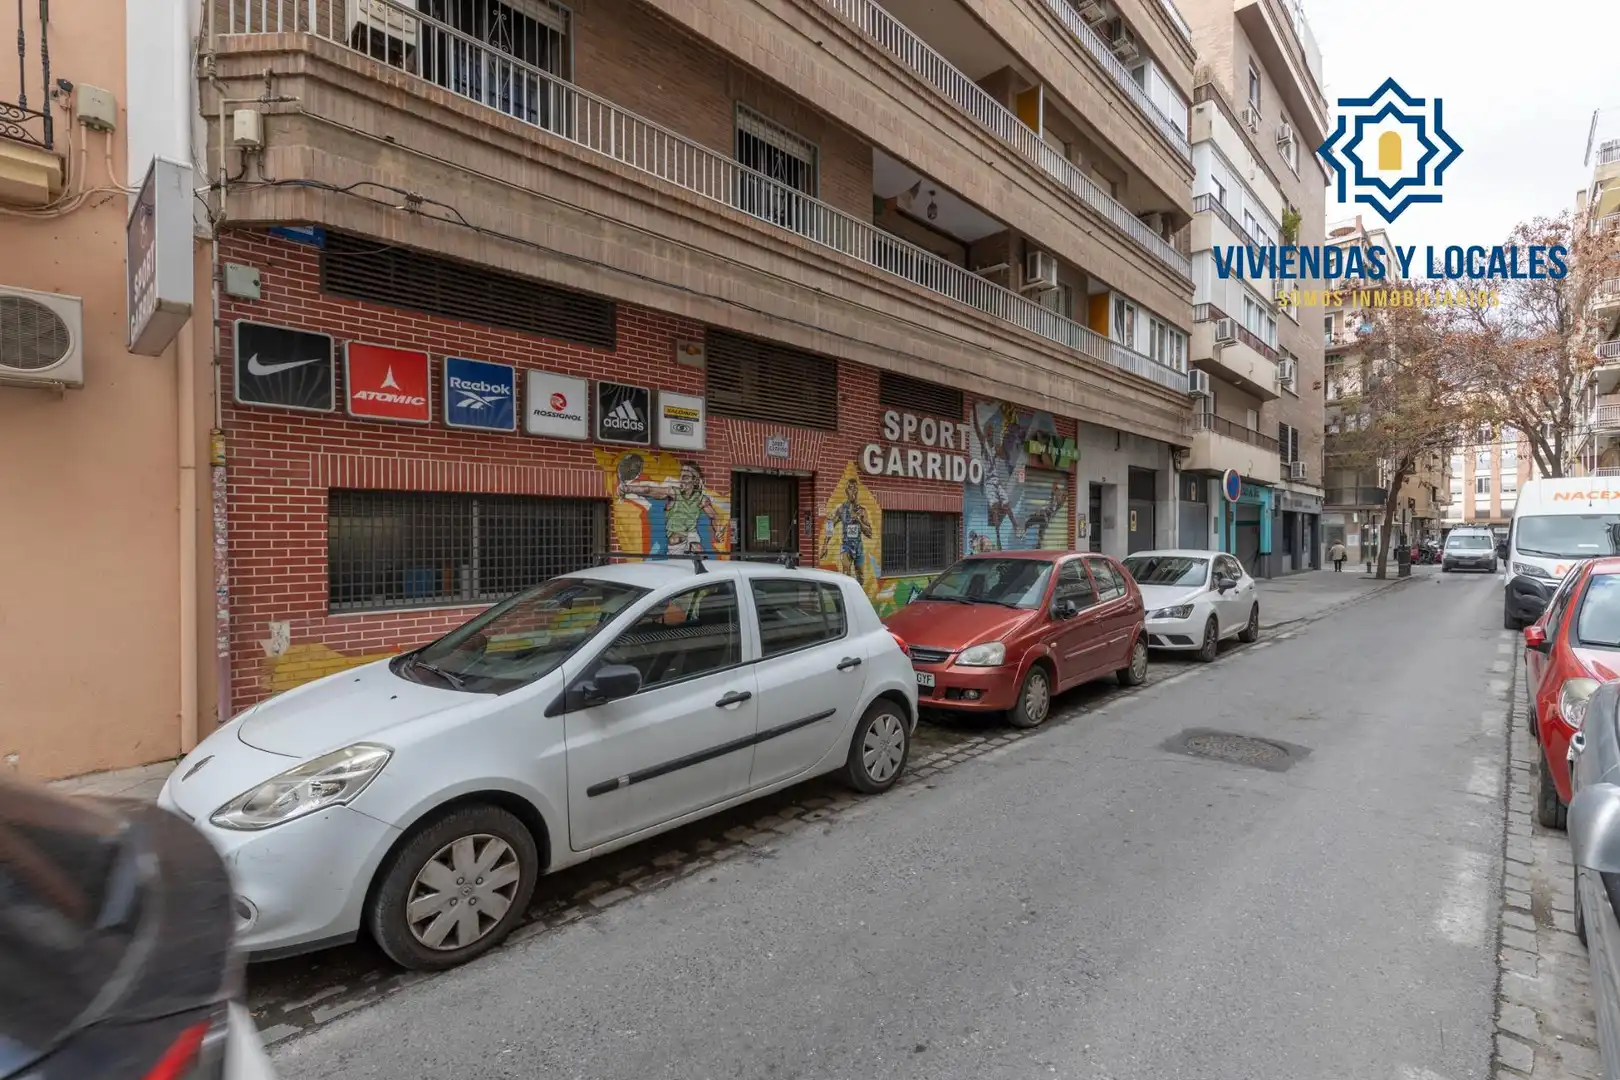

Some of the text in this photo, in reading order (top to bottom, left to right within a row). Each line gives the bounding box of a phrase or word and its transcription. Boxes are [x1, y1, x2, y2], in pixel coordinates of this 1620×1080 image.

[449, 376, 511, 396] Reebok
[352, 389, 427, 408] ATOMIC
[532, 408, 583, 422] ROSSIGNOL
[603, 415, 645, 432] adidas
[884, 410, 971, 450] SPORT
[863, 443, 983, 484] GARRIDO
[916, 672, 933, 685] GYF
